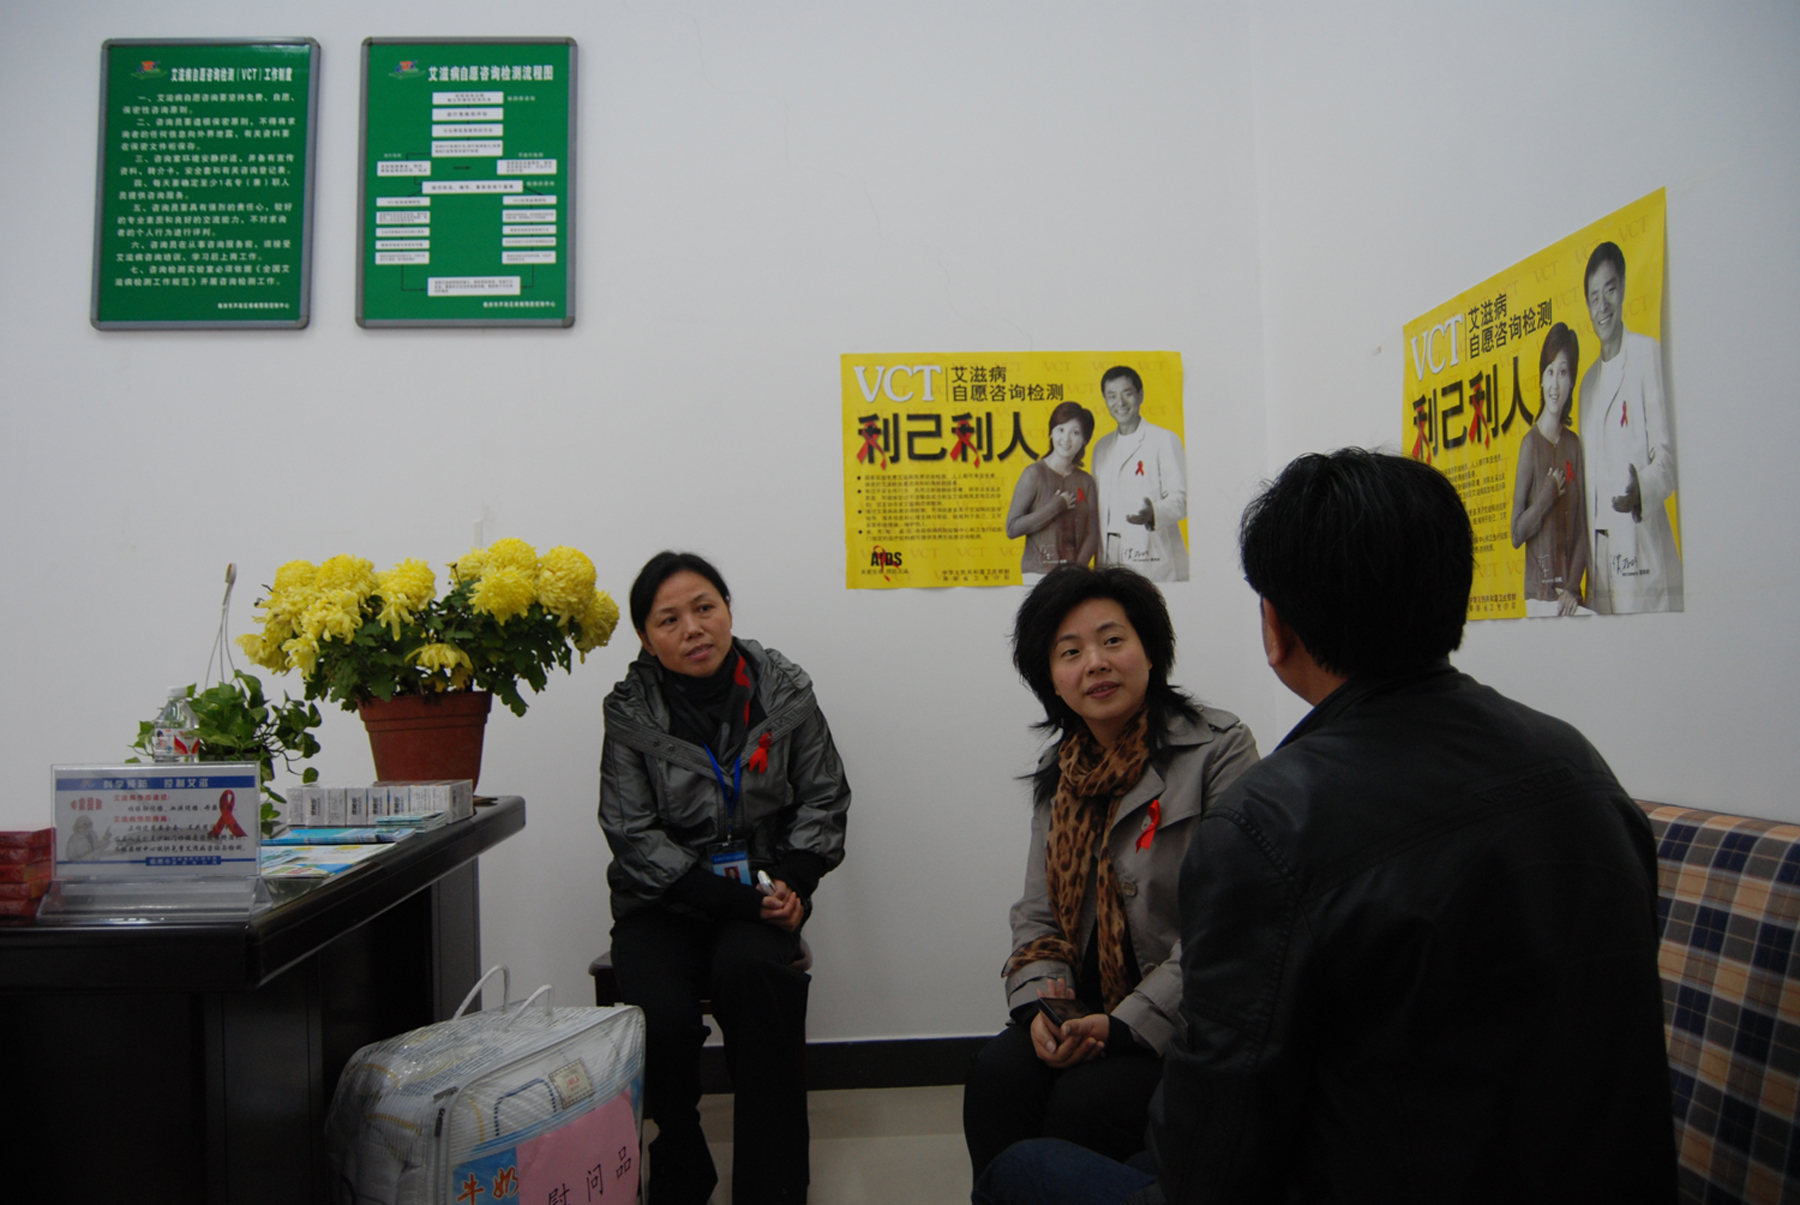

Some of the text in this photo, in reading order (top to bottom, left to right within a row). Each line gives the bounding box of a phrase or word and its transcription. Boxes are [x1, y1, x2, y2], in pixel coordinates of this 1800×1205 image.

[428, 65, 554, 81] 艾滋病自愿咨询检测流程图
[123, 106, 193, 114] 保密性咨询原则。
[1468, 292, 1507, 333] 艾滋病
[1470, 298, 1553, 360] 自愿咨询检测
[1410, 313, 1464, 382] VCT
[853, 364, 942, 402] VCT
[951, 365, 1007, 384] 艾滋病
[952, 384, 1064, 402] 自愿咨询检测
[1413, 356, 1534, 463] 利己利人
[857, 412, 1040, 468] 利己利人
[103, 778, 209, 789] 科学预防 控制艾滋
[456, 1166, 519, 1205] 牛奶
